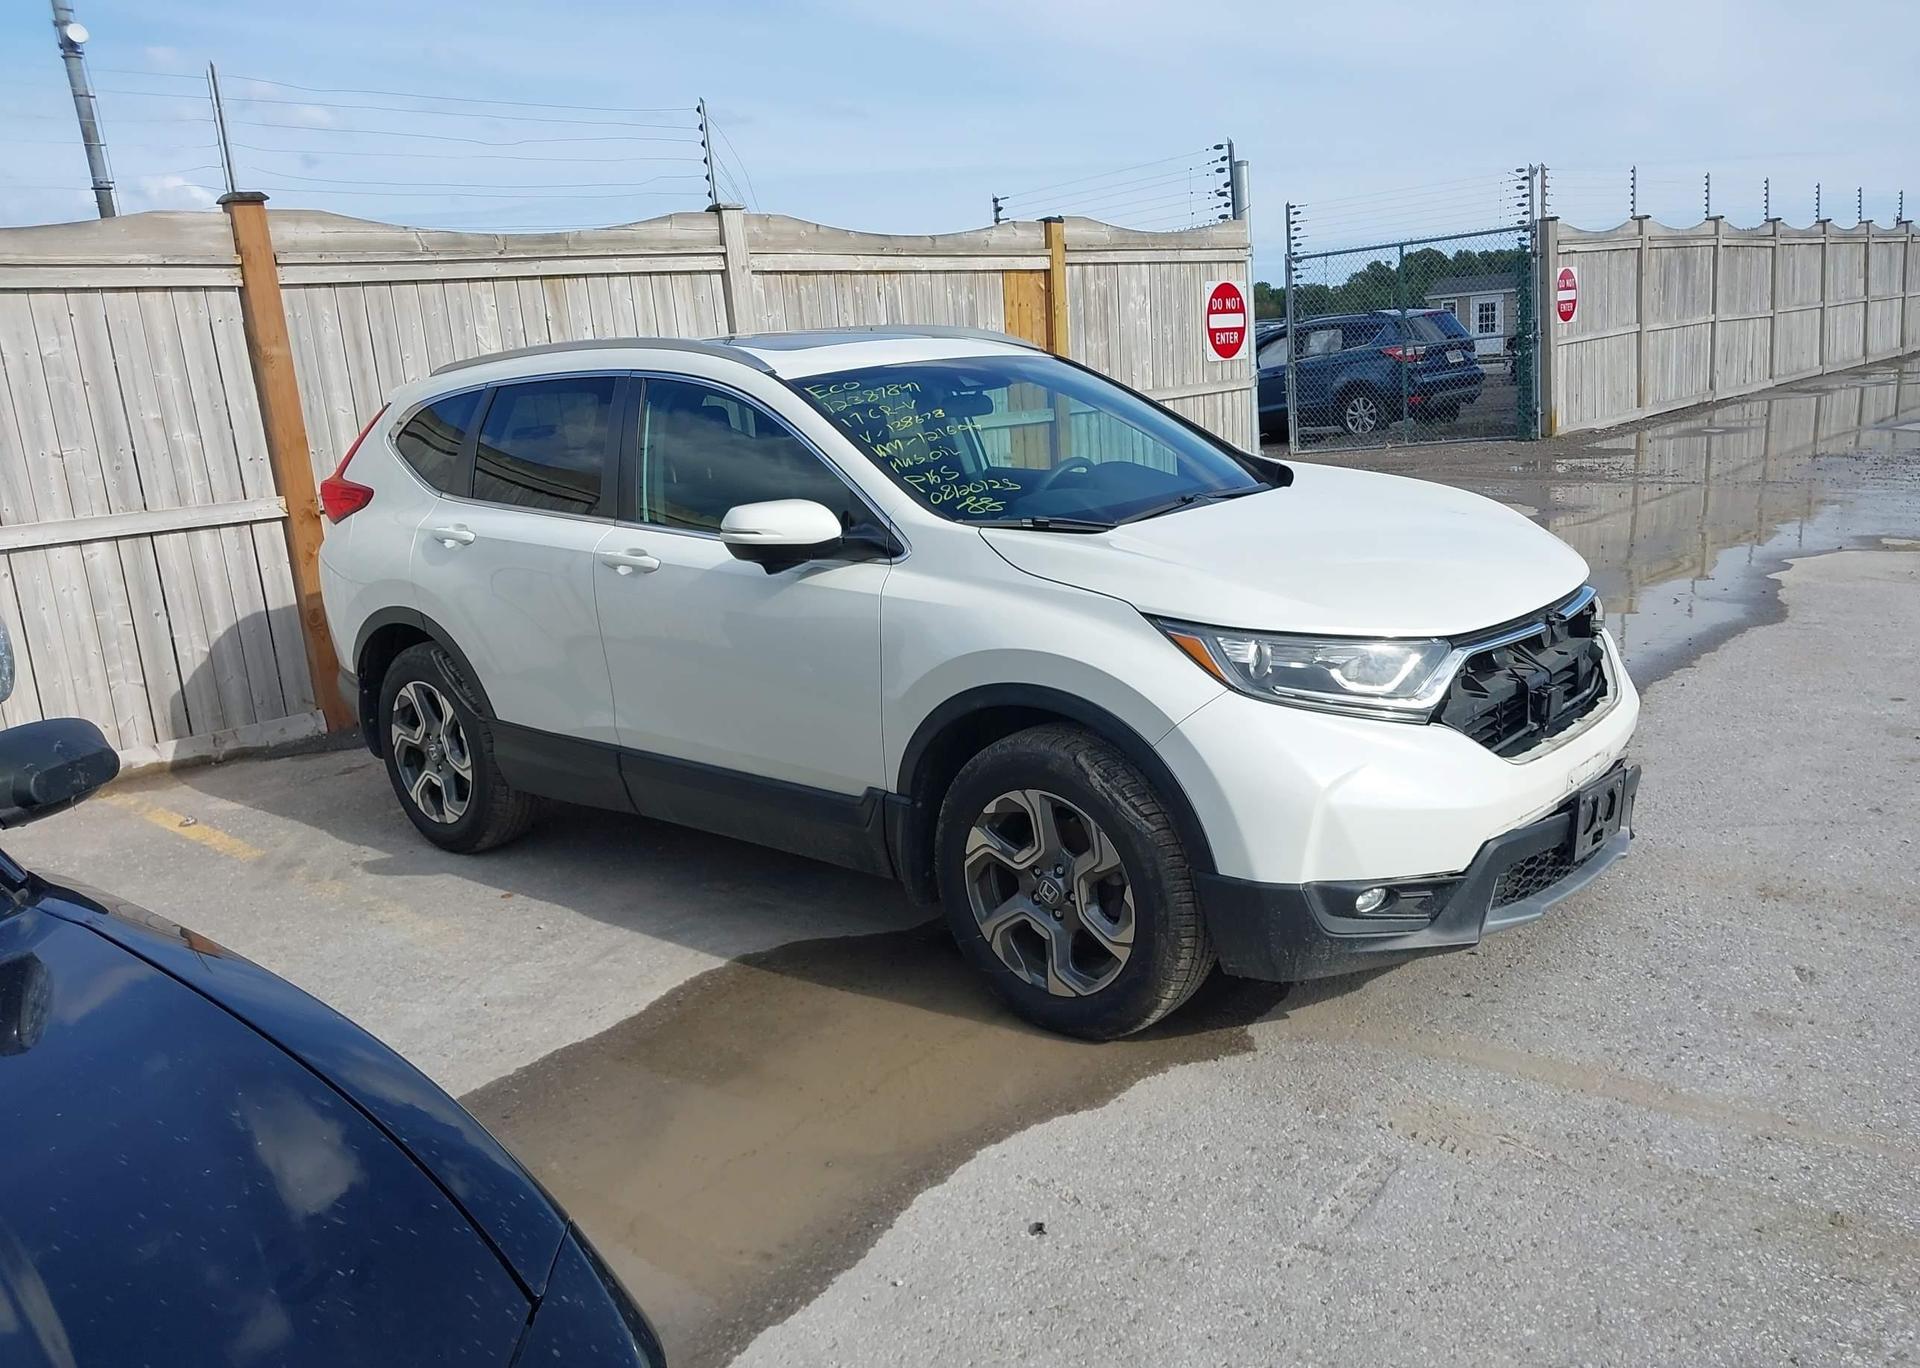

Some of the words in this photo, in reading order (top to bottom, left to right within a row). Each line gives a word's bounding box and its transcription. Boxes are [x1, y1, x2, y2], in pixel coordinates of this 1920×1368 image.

[1212, 298, 1222, 310] DO
[1226, 297, 1240, 309] NOT
[1215, 331, 1239, 344] ENTER
